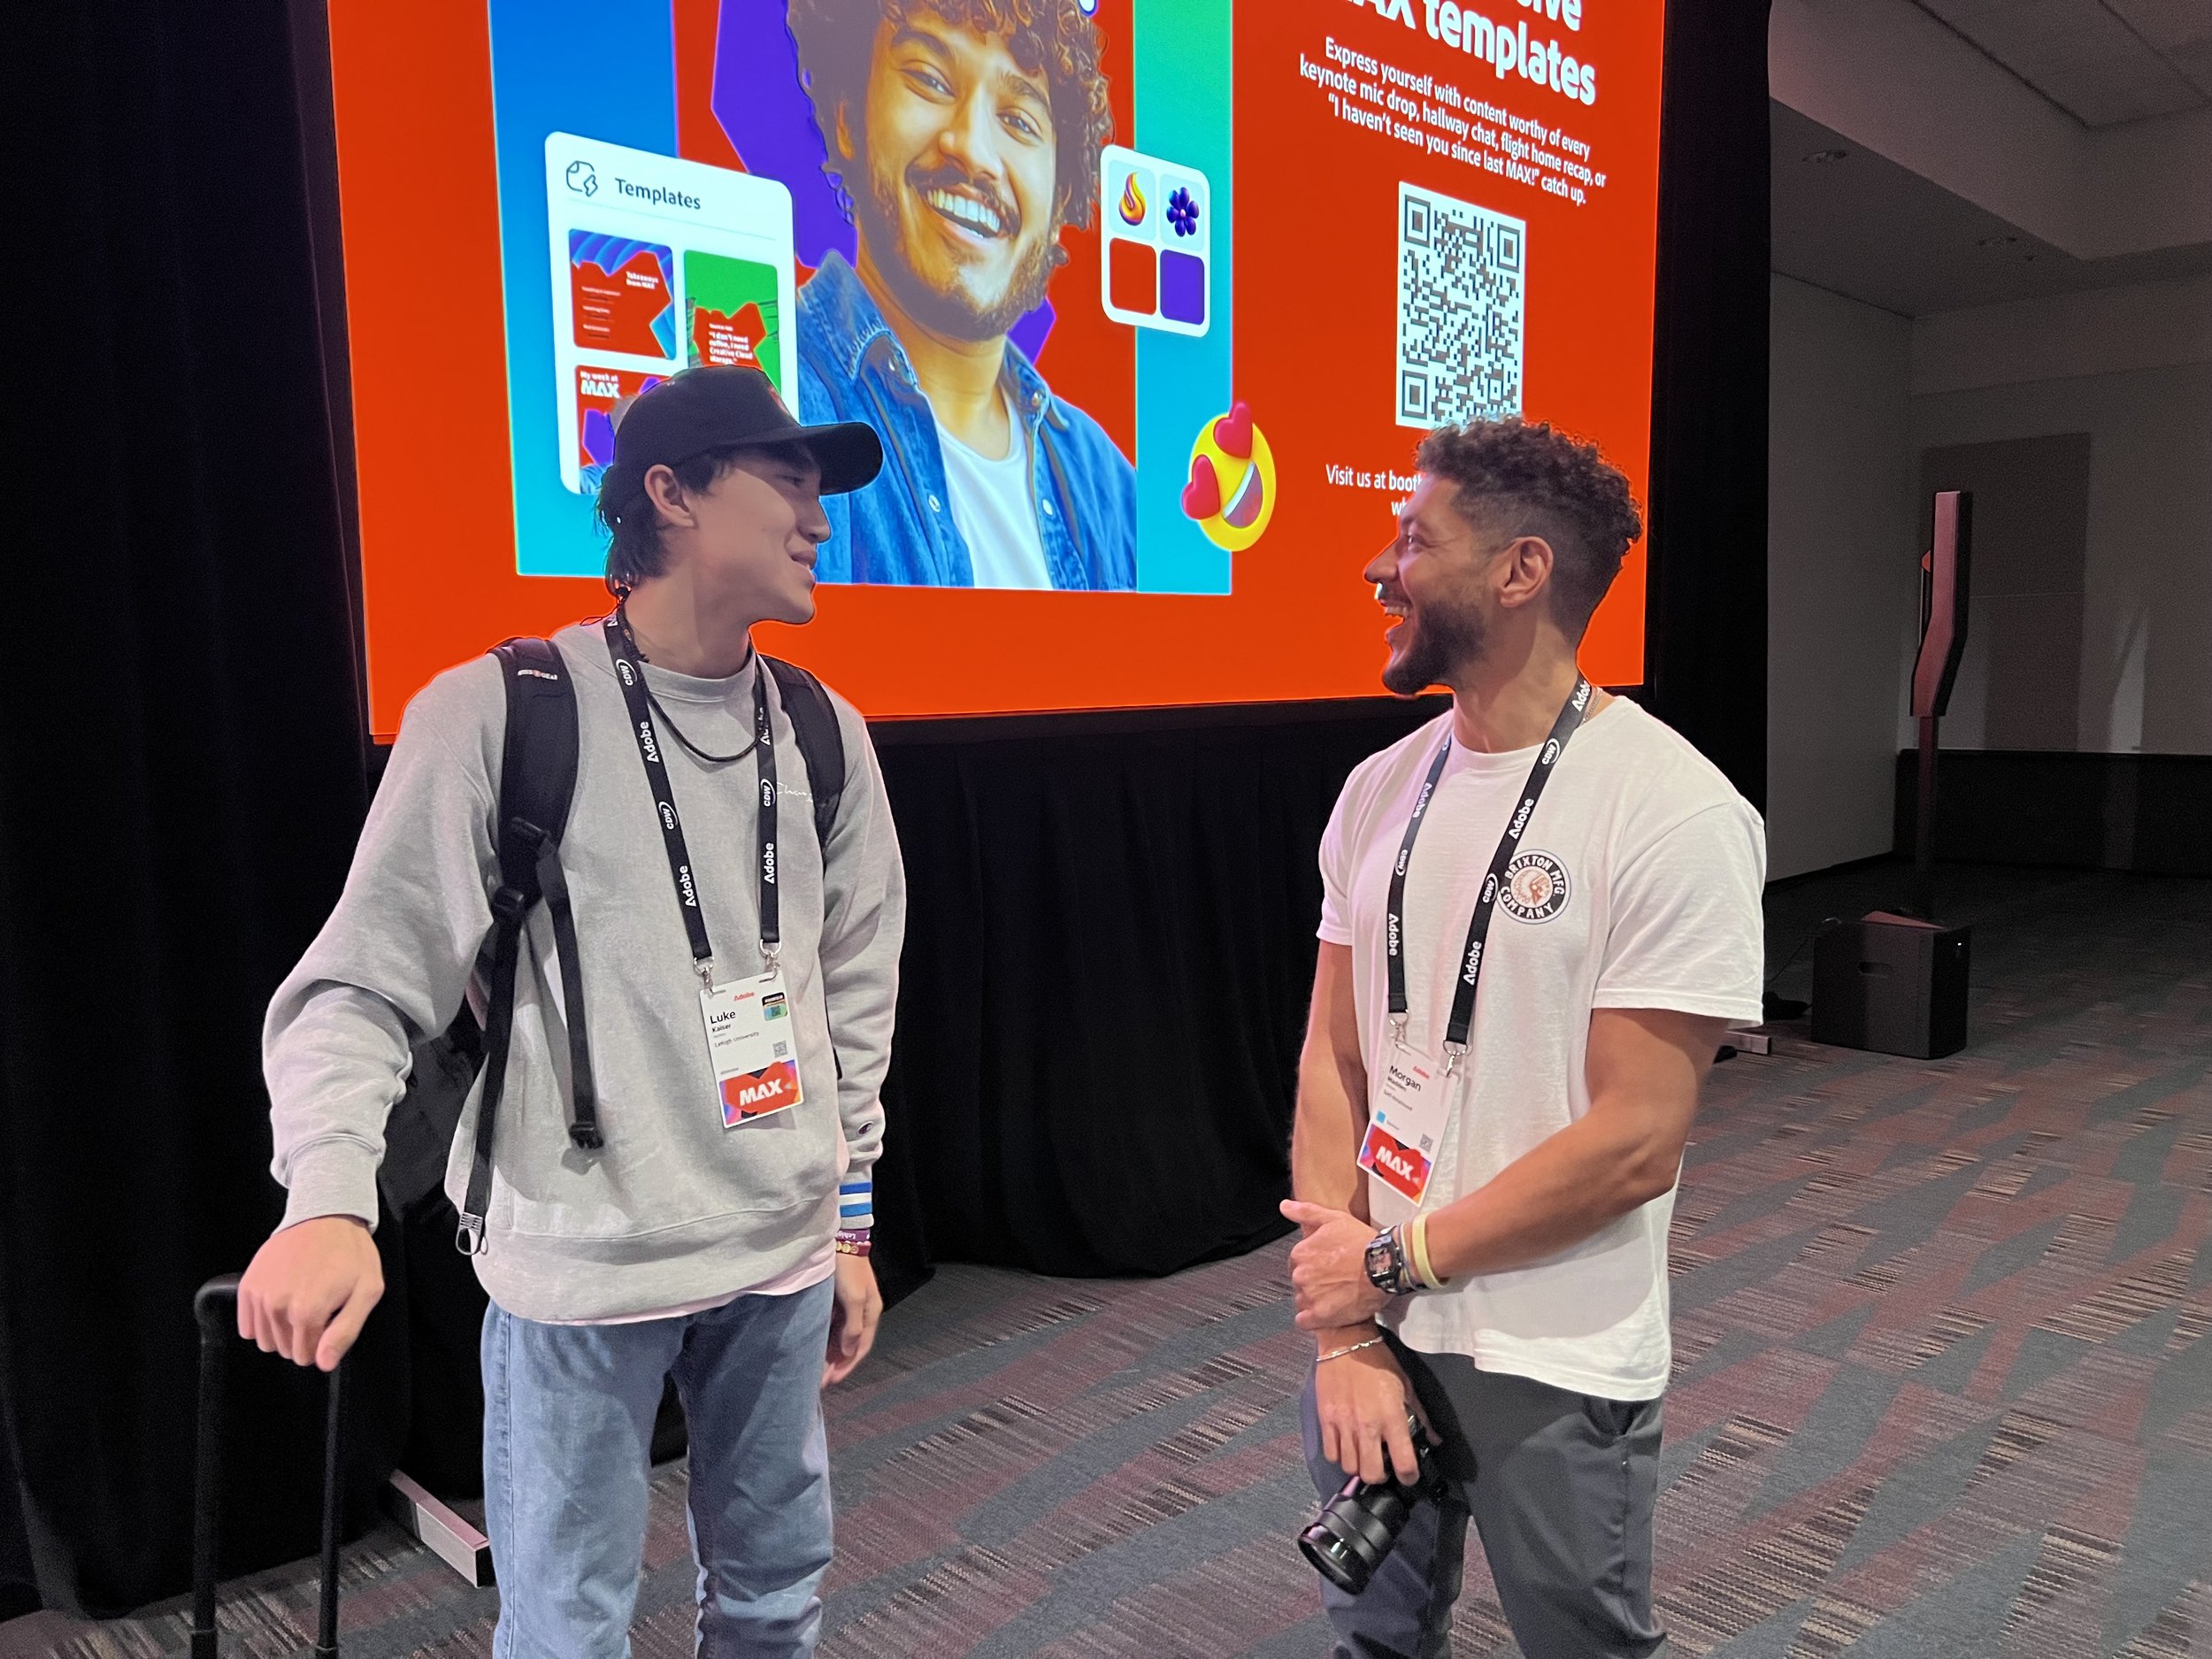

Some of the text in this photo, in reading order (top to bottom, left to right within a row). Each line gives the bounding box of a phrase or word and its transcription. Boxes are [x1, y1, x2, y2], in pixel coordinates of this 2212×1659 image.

[1424, 0, 1595, 105] templates
[1325, 36, 1590, 163] Express yourself with content worthy of every
[1300, 52, 1607, 188] keynote mic drop, hallway chat, flight home recap, or
[1342, 97, 1392, 135] haven't
[1394, 122, 1424, 147] seen
[1426, 134, 1448, 155] you
[1451, 140, 1481, 167] since
[1483, 150, 1503, 175] last
[1540, 175, 1569, 198] catch
[1571, 187, 1586, 206] up.
[615, 177, 701, 210] Templates
[580, 380, 621, 399] MAX
[1325, 464, 1354, 487] Visit
[1356, 472, 1371, 488] us
[1373, 471, 1386, 489] at
[640, 721, 660, 763] Adobe
[1412, 782, 1433, 818] Adobe
[1508, 798, 1535, 840] Adobe
[763, 842, 775, 884] Adobe
[1504, 856, 1554, 879] BRIXTON
[679, 865, 697, 907] Adobe
[1501, 886, 1554, 919] COMPANY
[1388, 913, 1400, 956] Adobe
[1463, 941, 1482, 986] Adobe
[710, 1011, 736, 1024] Luke
[711, 1024, 731, 1033] Kaiser
[739, 1078, 784, 1107] MAX
[1389, 1064, 1421, 1092] Morgan
[1375, 1146, 1414, 1181] MAX
